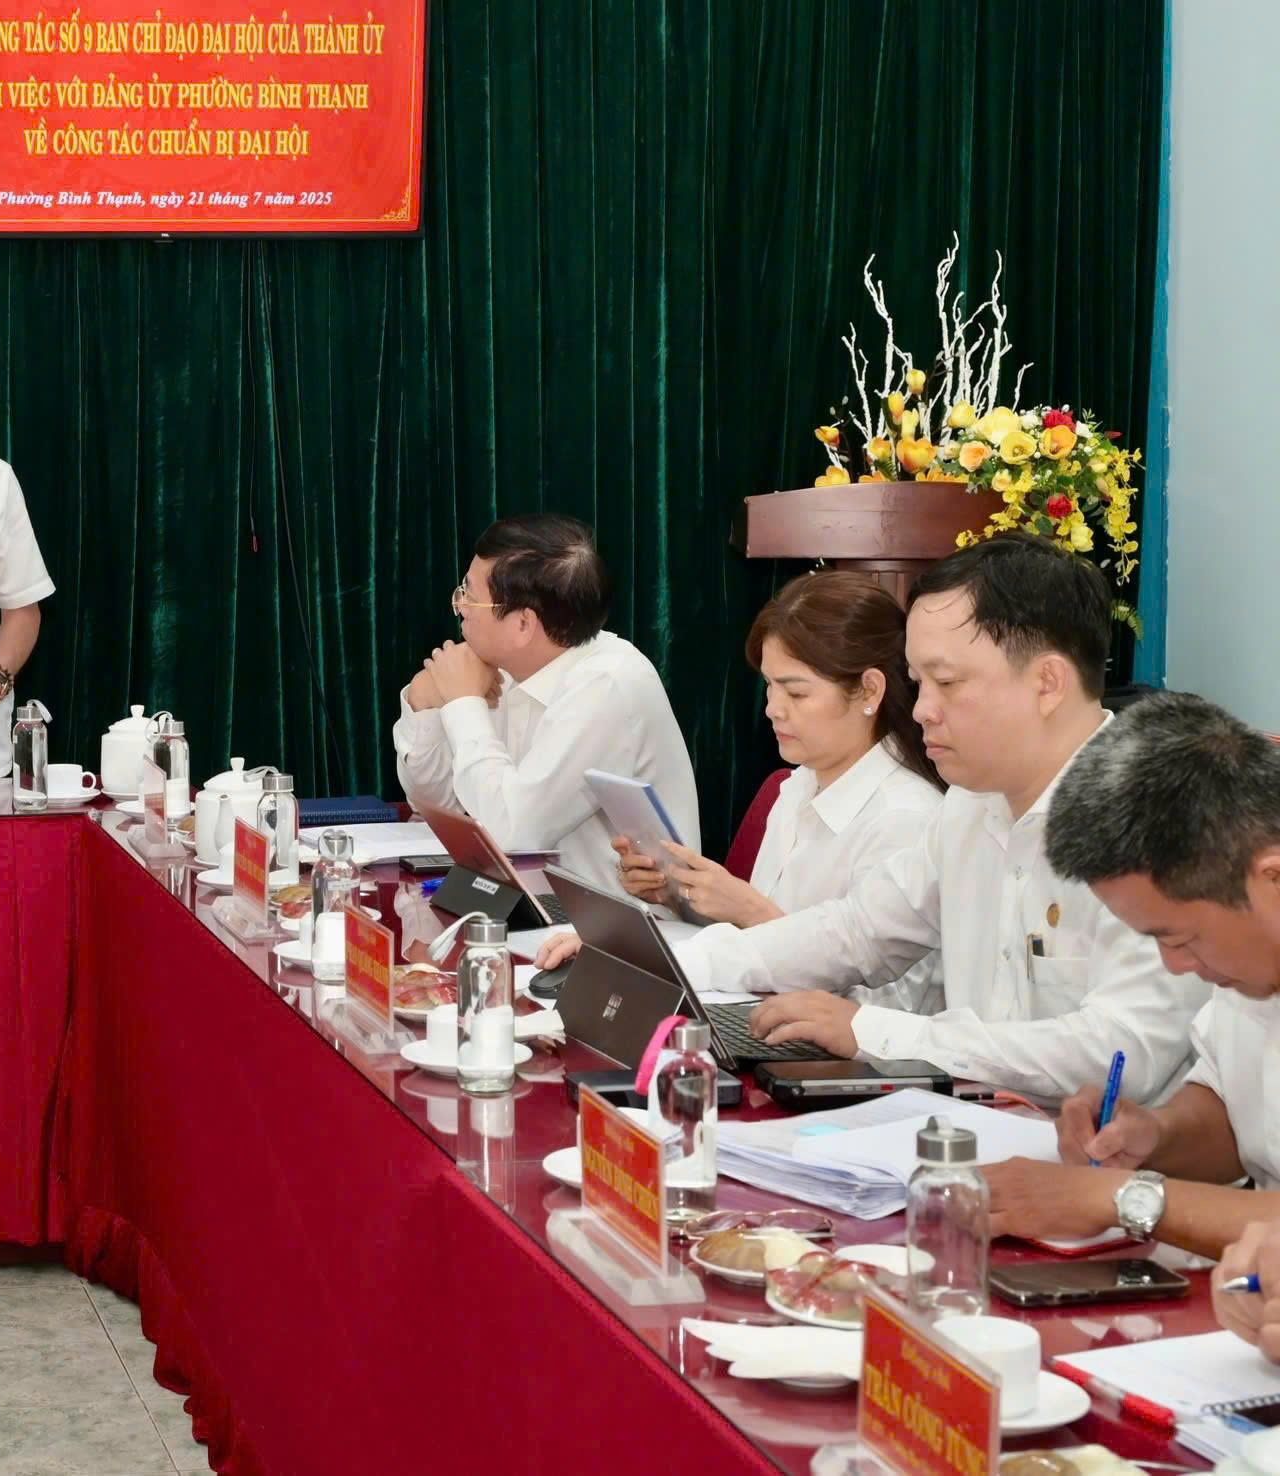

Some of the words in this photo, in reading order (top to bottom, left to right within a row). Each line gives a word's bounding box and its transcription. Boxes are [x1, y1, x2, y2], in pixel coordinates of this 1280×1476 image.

[24, 12, 56, 52] TÁC
[59, 8, 81, 52] SỐ
[84, 23, 93, 53] 9
[96, 22, 129, 53] BAN
[132, 10, 162, 53] CHỈ
[164, 23, 199, 60] ĐẠO
[202, 23, 231, 60] ĐẠI
[234, 14, 264, 61] HỘI
[268, 11, 300, 54] CỦA
[304, 15, 360, 54] THÀNH
[363, 11, 385, 54] ỦY
[7, 75, 51, 112] VIỆC
[55, 75, 88, 107] VỚI
[92, 73, 143, 108] ĐẢNG
[148, 72, 173, 108] ỦY
[177, 76, 253, 108] PHƯỜNG
[257, 76, 302, 109] BÌNH
[307, 84, 369, 114] THẠNH
[24, 117, 48, 155] VỀ
[53, 123, 104, 155] CÔNG
[107, 123, 144, 155] TÁC
[148, 118, 211, 155] CHUẨN
[215, 130, 234, 160] BỊ
[238, 130, 271, 160] ĐẠI
[275, 123, 309, 160] HỘI
[57, 191, 92, 205] Bình
[97, 191, 146, 208] Thạnh,
[150, 192, 185, 208] ngày
[187, 192, 205, 205] 21
[208, 191, 249, 208] tháng
[254, 192, 262, 205] 7
[264, 191, 295, 205] năm
[298, 192, 333, 205] 2025
